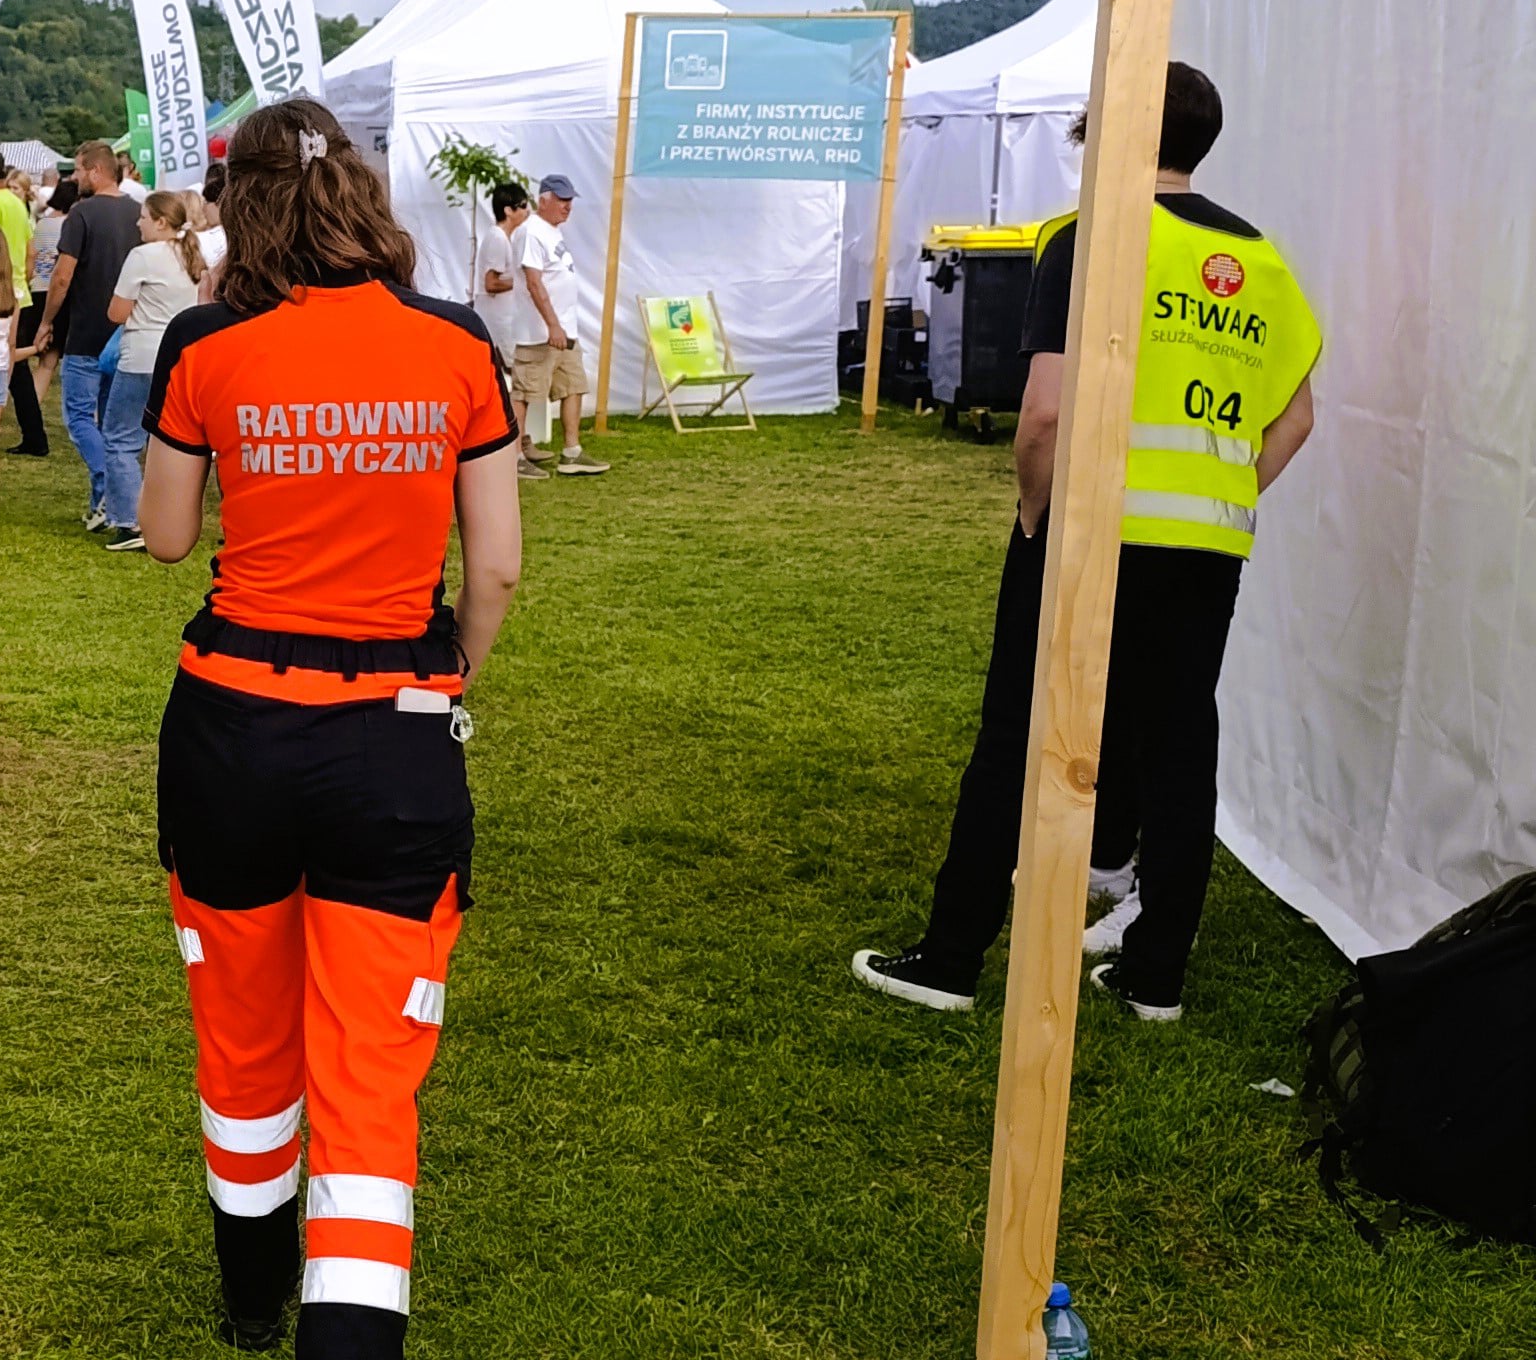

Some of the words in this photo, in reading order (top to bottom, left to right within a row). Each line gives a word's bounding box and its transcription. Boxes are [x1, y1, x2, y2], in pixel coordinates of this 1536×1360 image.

[695, 102, 753, 121] FIRMY,
[757, 104, 866, 121] INSTYTUCJE
[677, 124, 688, 140] Z
[692, 122, 764, 140] BRANŻY
[766, 125, 864, 142] ROLNICZEJ
[660, 145, 665, 161] I
[669, 143, 820, 166] PRZETWÓRSTWA,
[824, 148, 862, 164] RHD
[1153, 291, 1268, 347] STWAR
[236, 400, 450, 438] RATOWNIK
[240, 439, 448, 475] MEDYCZNY
